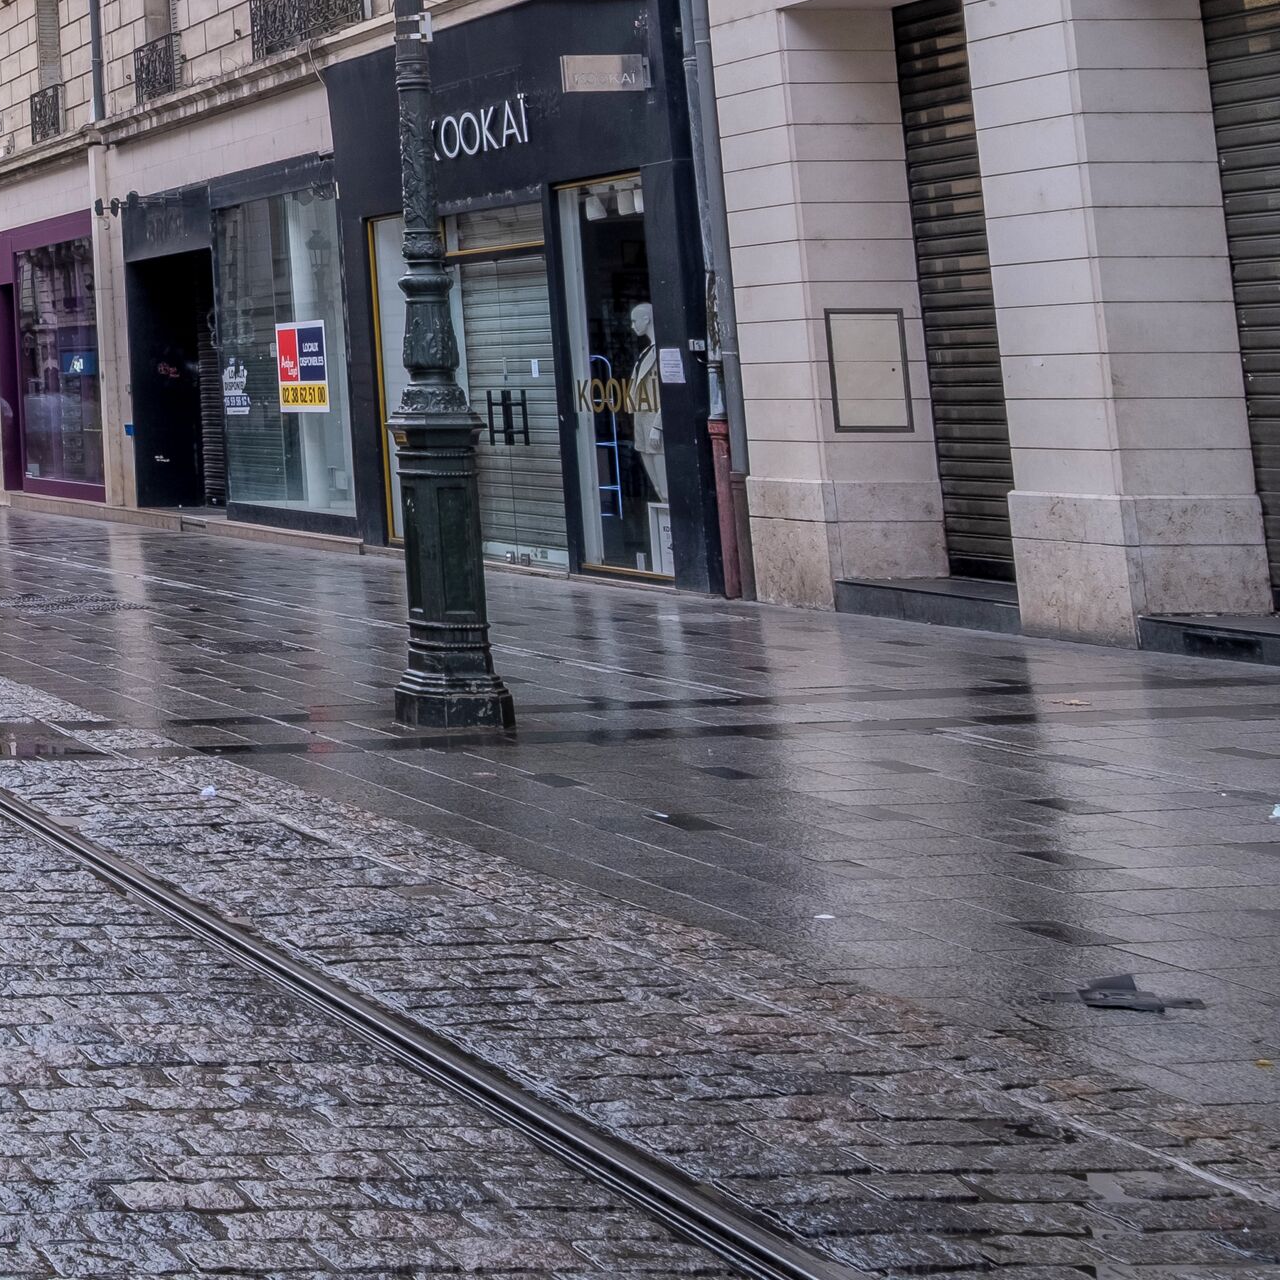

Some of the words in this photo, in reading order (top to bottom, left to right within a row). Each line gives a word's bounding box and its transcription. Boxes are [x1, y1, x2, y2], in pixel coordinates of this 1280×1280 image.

[430, 92, 529, 161] OOKAÏ
[282, 386, 290, 403] 02
[291, 386, 299, 403] 38
[300, 386, 308, 403] 62
[308, 386, 316, 403] 51
[577, 370, 660, 414] KOOKAÏ
